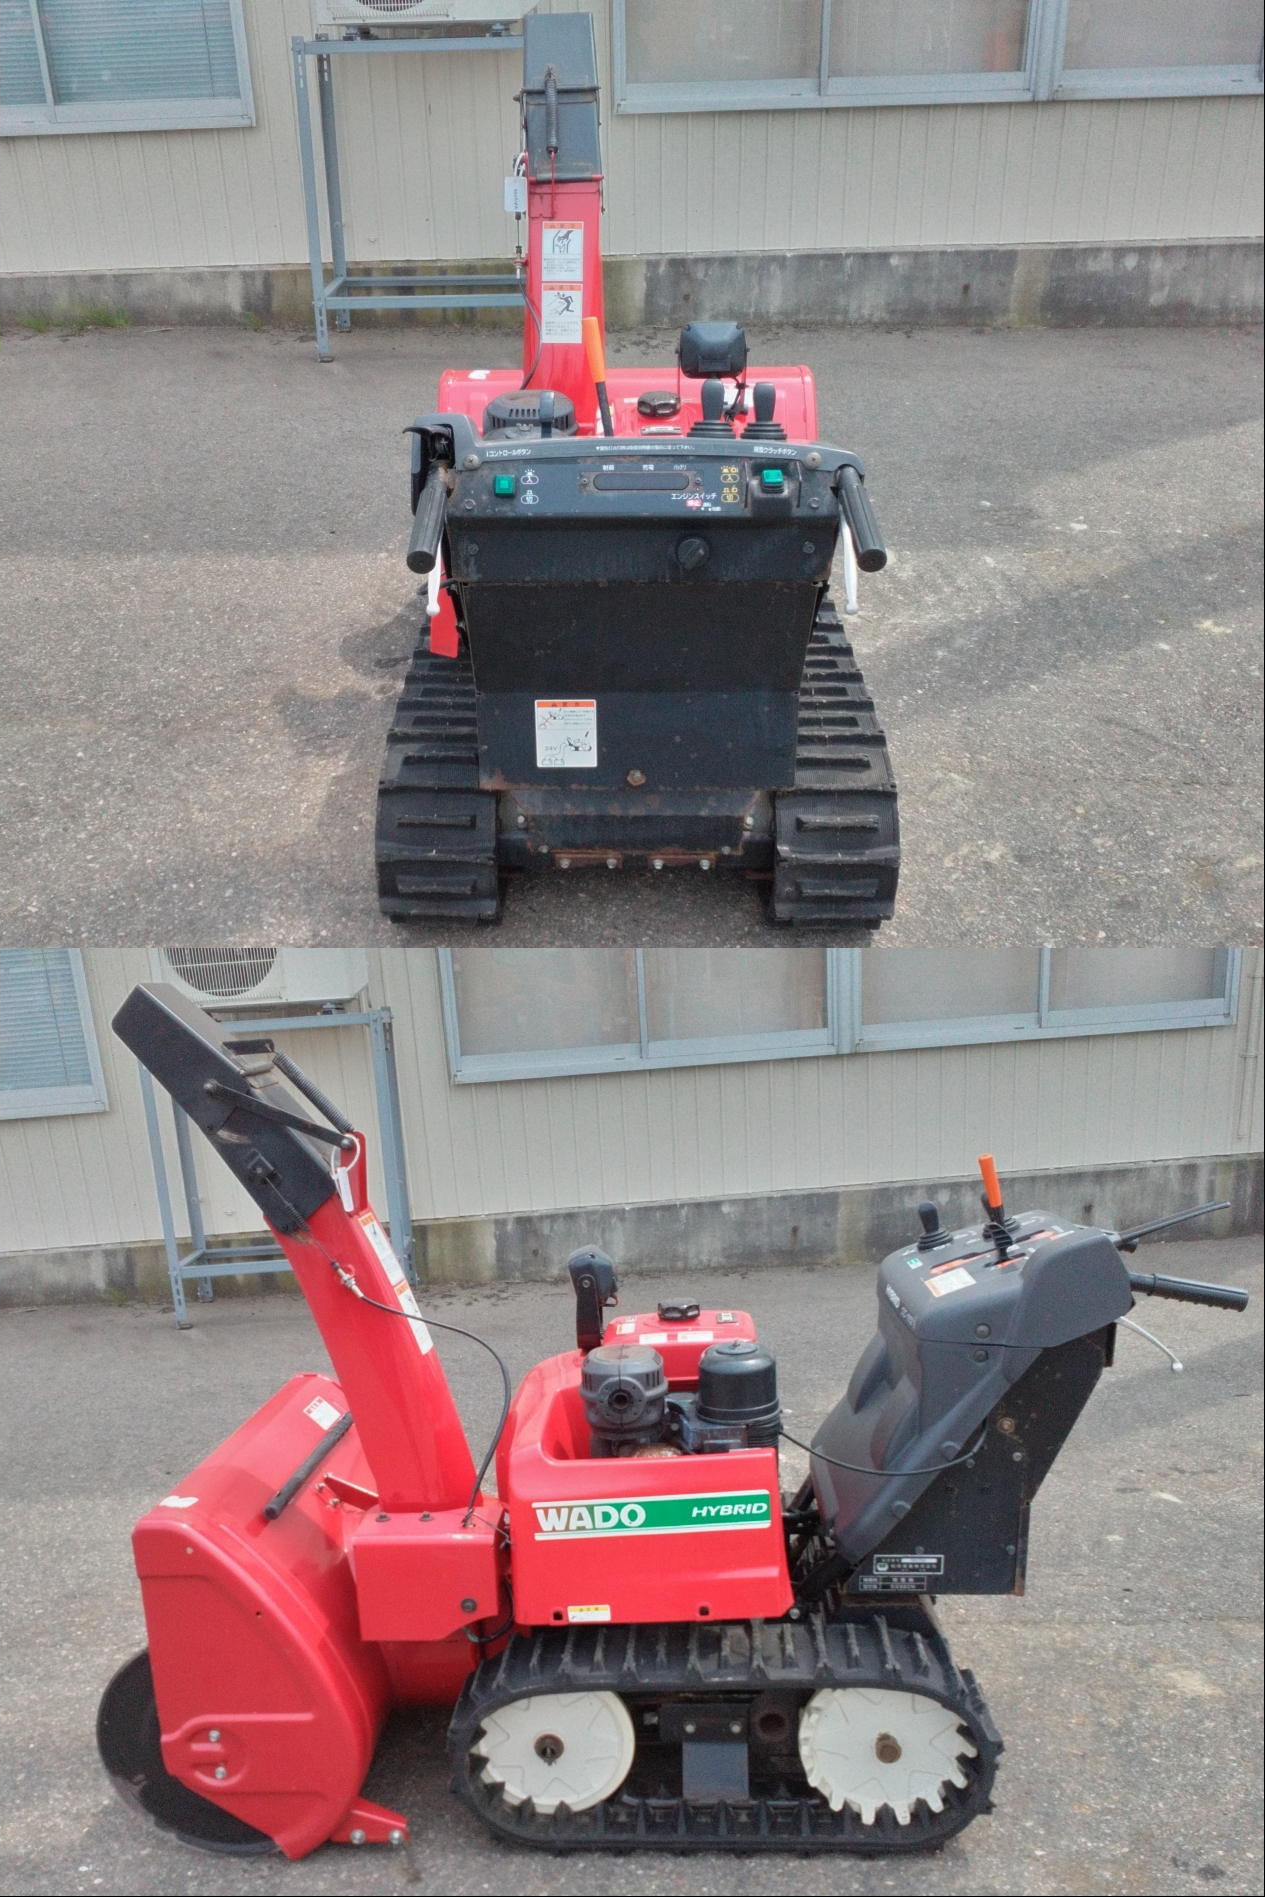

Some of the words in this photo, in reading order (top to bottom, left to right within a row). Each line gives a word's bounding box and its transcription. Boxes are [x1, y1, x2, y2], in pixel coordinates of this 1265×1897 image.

[671, 492, 717, 500] エンジンスイッチ
[535, 1503, 646, 1532] WADO
[691, 1502, 768, 1518] HYBRID
